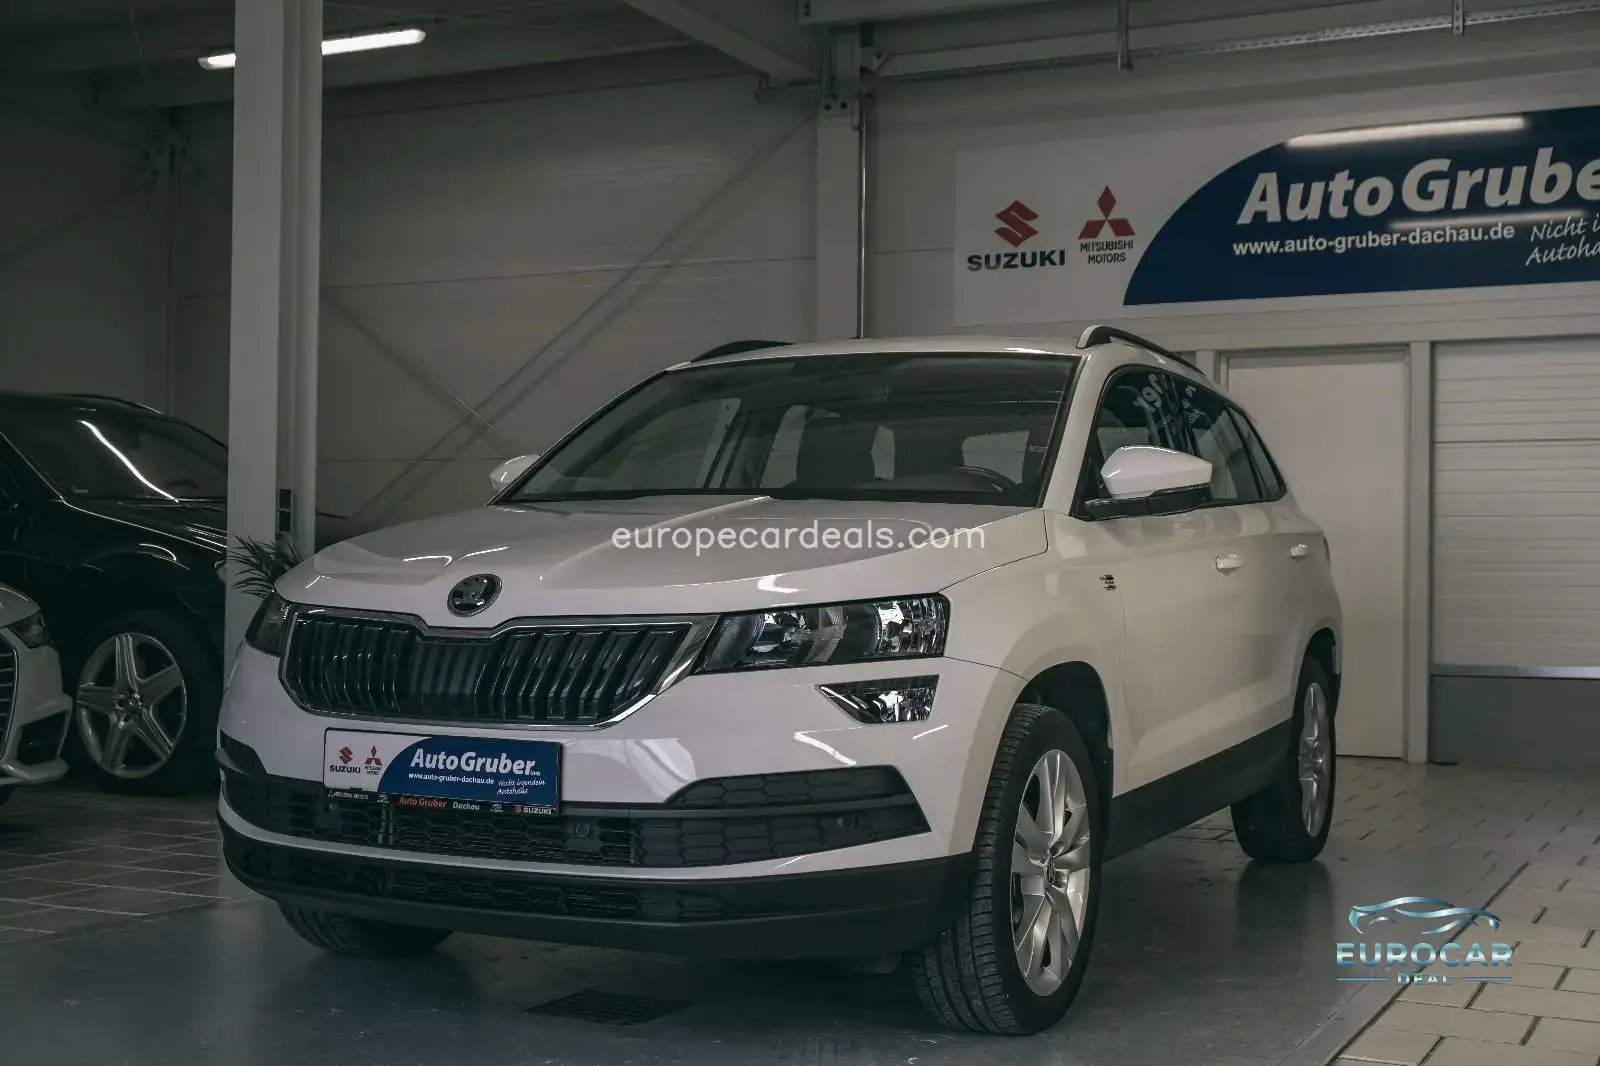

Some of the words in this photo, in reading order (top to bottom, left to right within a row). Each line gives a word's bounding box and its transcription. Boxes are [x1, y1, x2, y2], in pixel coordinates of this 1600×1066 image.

[1530, 215, 1588, 242] Nicht
[1080, 240, 1134, 252] MITSUBISHI
[1233, 222, 1515, 256] www.auto-gruber-dachau.de
[967, 249, 1066, 272] SUZUKI
[1087, 252, 1126, 264] MOTORS
[329, 765, 361, 774] SUZUKI
[408, 773, 495, 785] www.auto-gruber-dachau.de
[398, 796, 417, 806] Auto
[419, 798, 447, 808] Gruber
[452, 801, 480, 811] Dachau
[523, 807, 552, 815] SUZUKI
